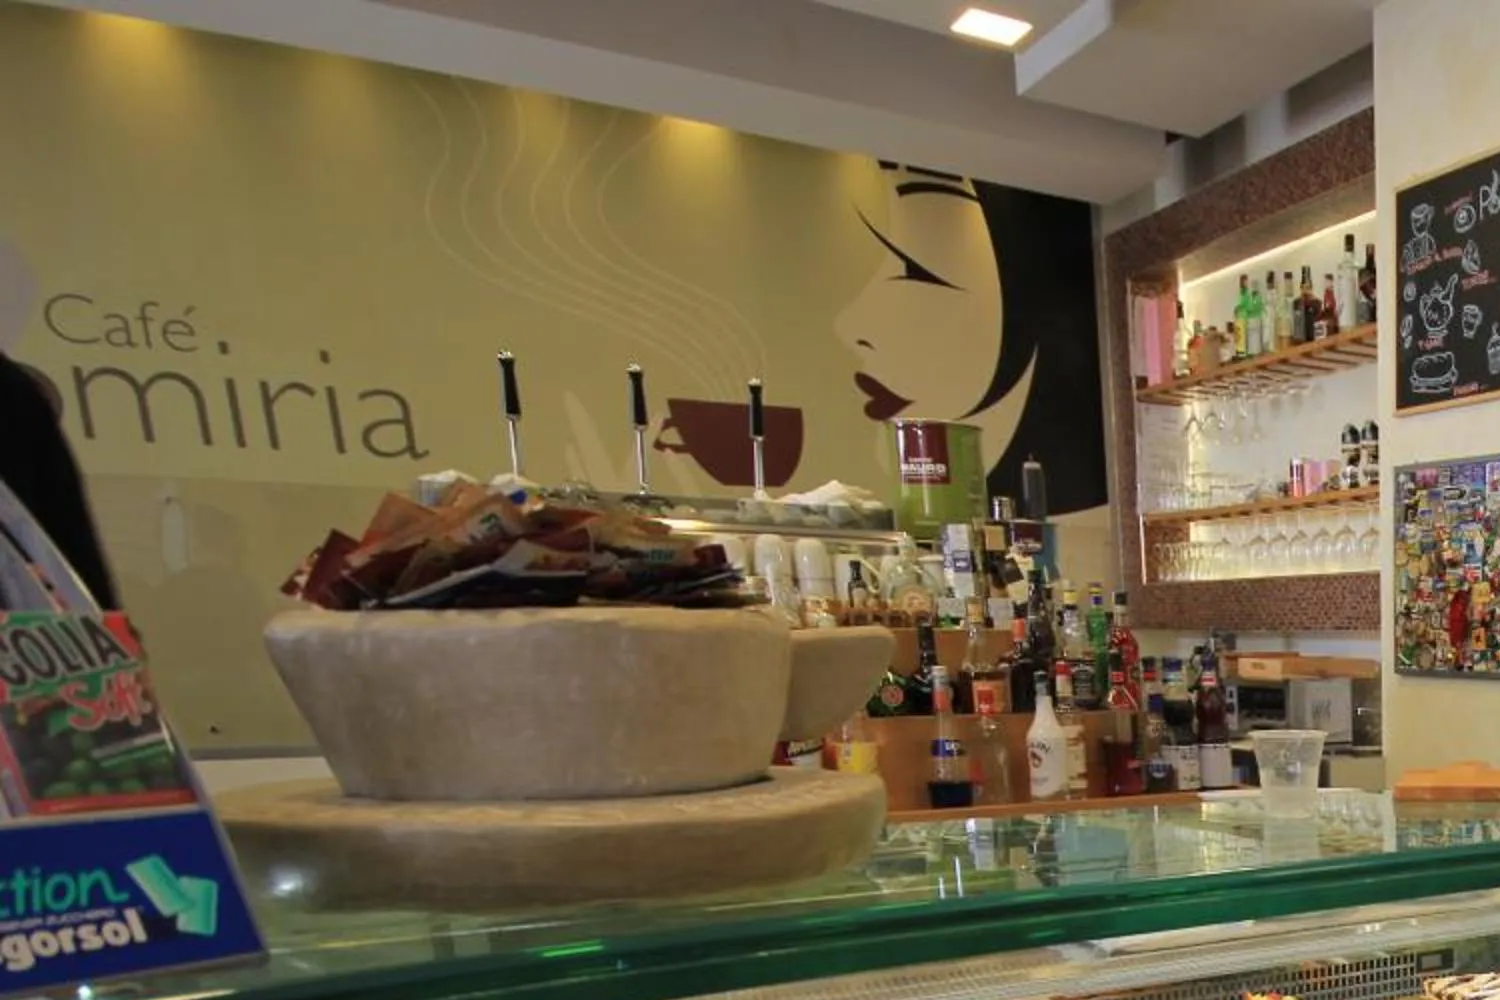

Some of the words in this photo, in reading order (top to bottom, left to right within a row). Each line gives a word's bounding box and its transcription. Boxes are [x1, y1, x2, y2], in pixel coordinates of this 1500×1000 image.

[44, 293, 200, 353] Café
[71, 340, 430, 460] miria
[0, 905, 147, 971] gorsol
